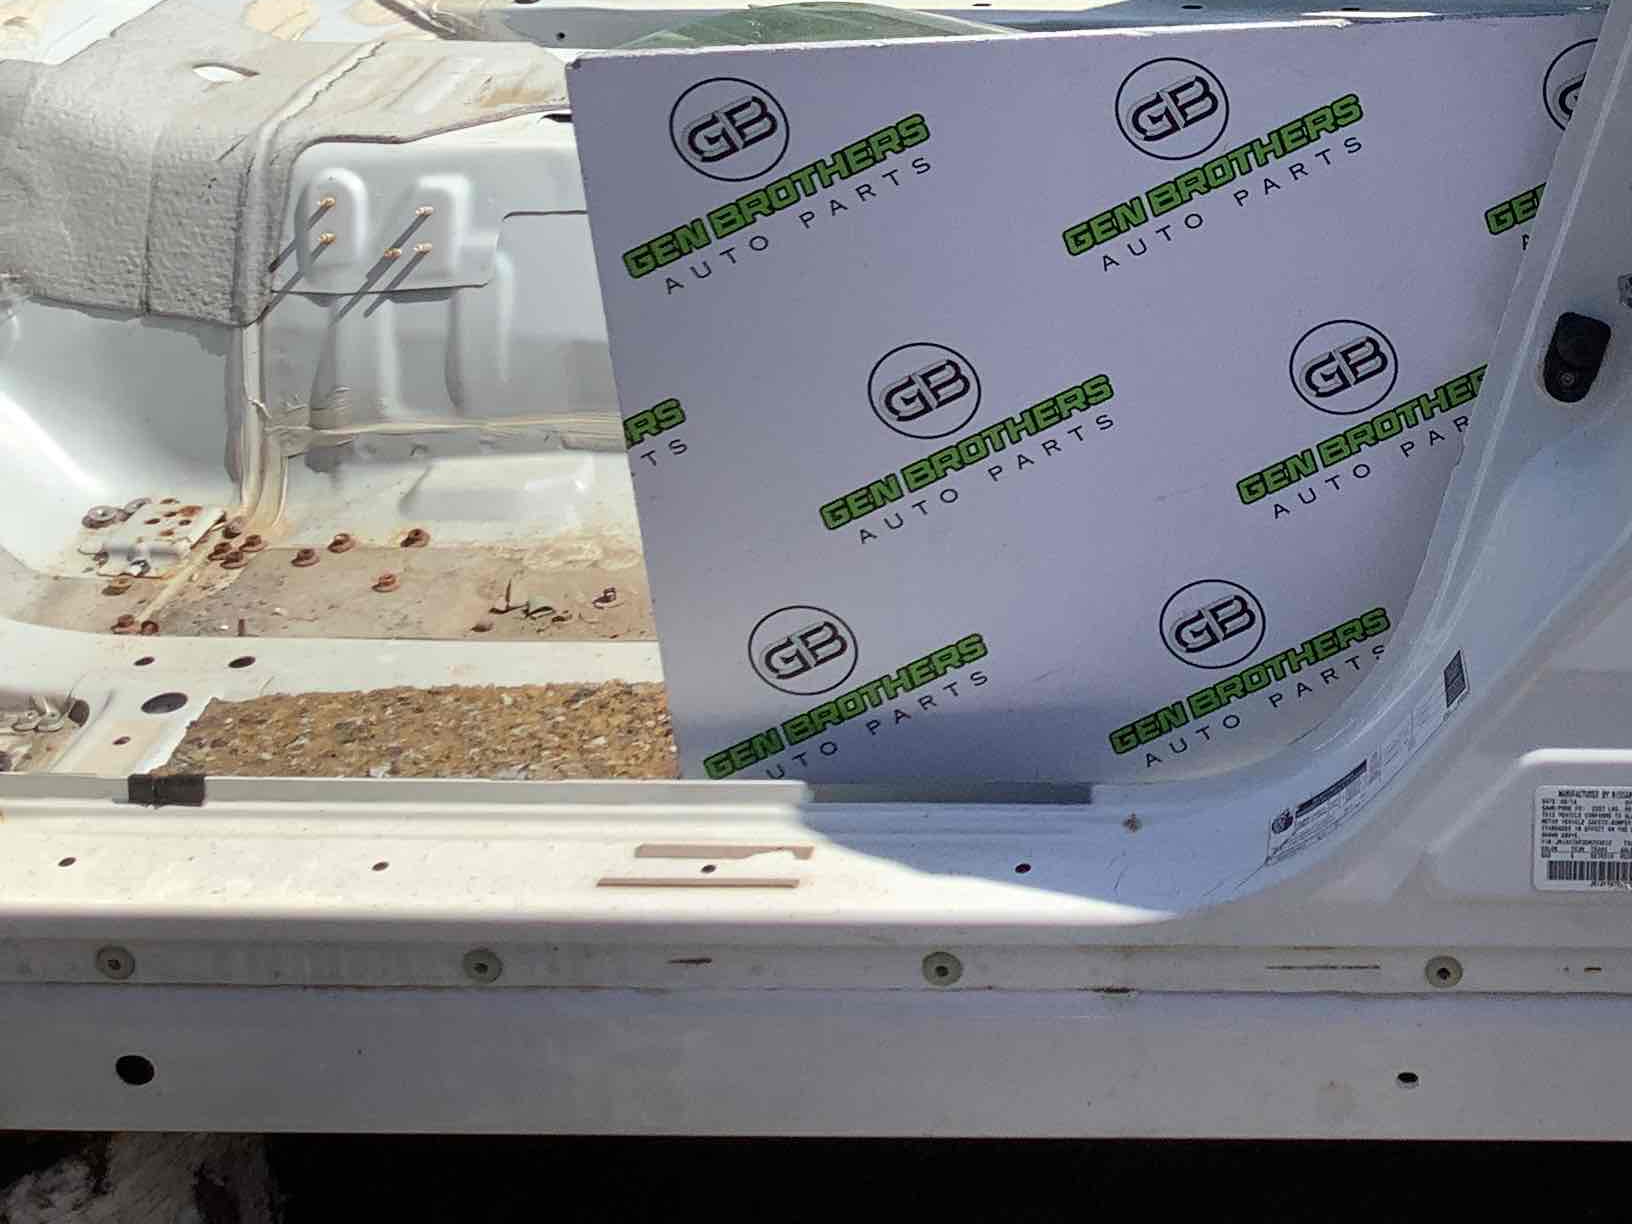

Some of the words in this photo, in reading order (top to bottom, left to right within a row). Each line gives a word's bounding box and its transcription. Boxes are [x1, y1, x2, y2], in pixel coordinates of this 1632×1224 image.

[683, 96, 778, 163] GB
[1129, 75, 1218, 142] GB
[622, 219, 711, 278] GEN
[708, 113, 931, 239] BROTHERS
[664, 235, 769, 295] AUTO
[799, 158, 931, 230] PARTS
[1063, 196, 1148, 256] GEN
[1147, 94, 1363, 216] BROTHERS
[1102, 213, 1204, 272] AUTO
[1233, 136, 1363, 206] PARTS
[1484, 183, 1546, 235] GE
[880, 359, 970, 422] GB
[1300, 336, 1388, 398] GB
[819, 473, 903, 530] GEN
[901, 374, 1114, 493] BROTHERS
[859, 487, 959, 545] AUTO
[988, 414, 1114, 482] PARTS
[1236, 448, 1318, 504] GEN
[1316, 364, 1488, 468] BROTHE
[1272, 463, 1371, 519] AUTO
[1400, 414, 1470, 458] PAR
[760, 621, 847, 680] GB
[1108, 701, 1189, 754] GEN
[1187, 607, 1391, 719] BROTHERS
[1171, 595, 1256, 653] GB
[704, 727, 783, 779] GEN
[782, 633, 988, 745] BROTHERS
[767, 740, 839, 780] UTO
[867, 670, 988, 735] PARTS
[1145, 714, 1241, 767] AUTO
[1269, 644, 1386, 708] PARTS
